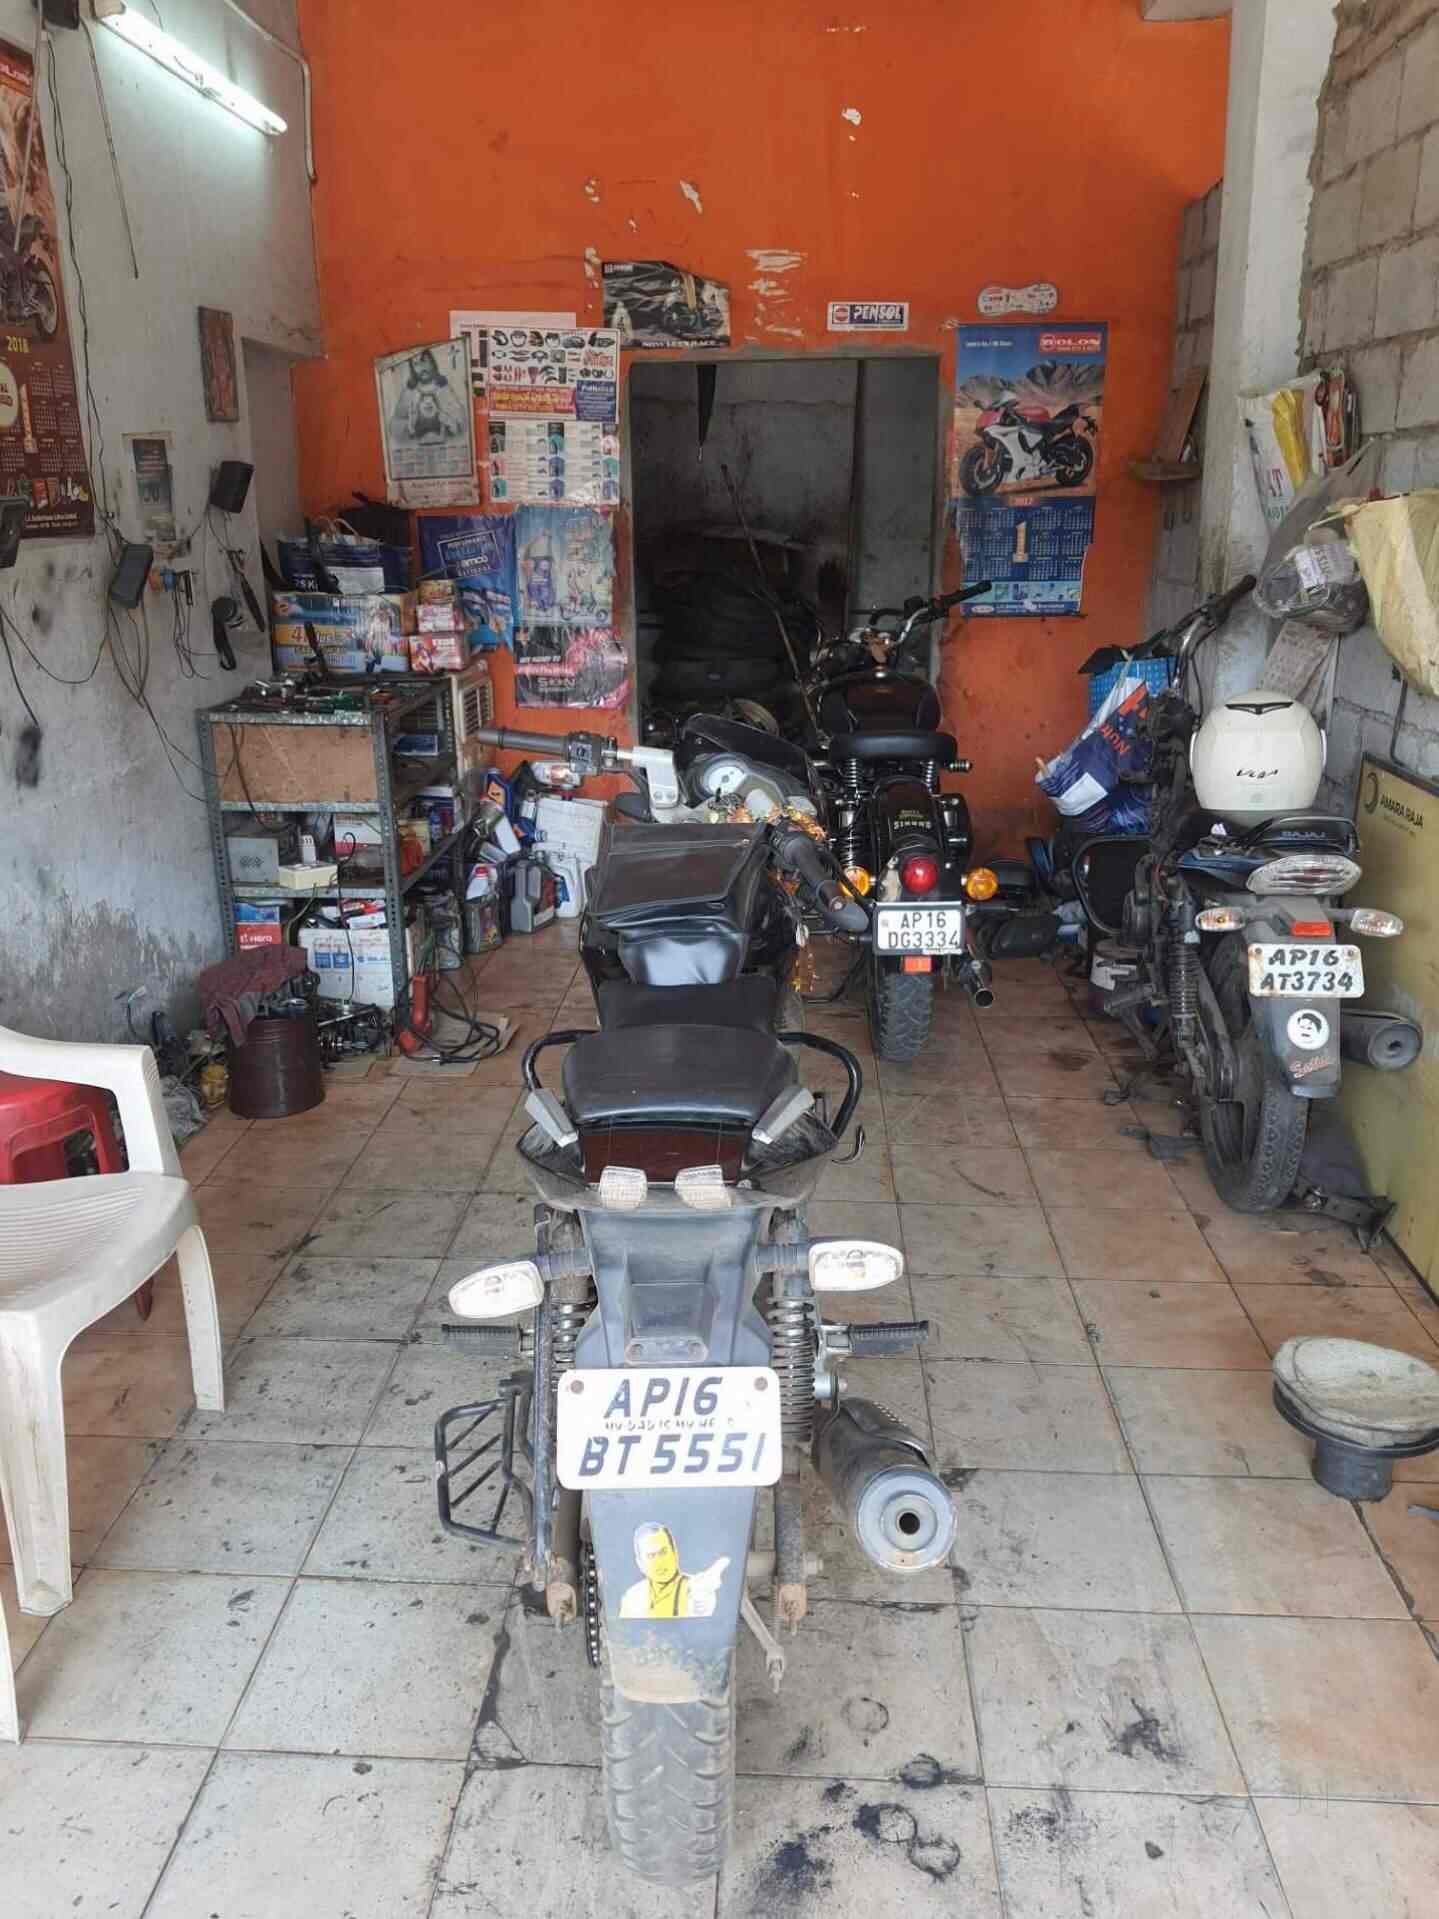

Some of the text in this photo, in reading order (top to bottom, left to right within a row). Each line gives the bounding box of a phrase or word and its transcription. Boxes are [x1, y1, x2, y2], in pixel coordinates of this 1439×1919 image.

[854, 305, 902, 320] PENSOL
[900, 912, 947, 929] AP16
[888, 931, 959, 949] DG3334
[1268, 949, 1340, 966] AP16
[1259, 972, 1353, 991] AT3734
[603, 1376, 723, 1419] AP16
[578, 1432, 766, 1477] BT5551
